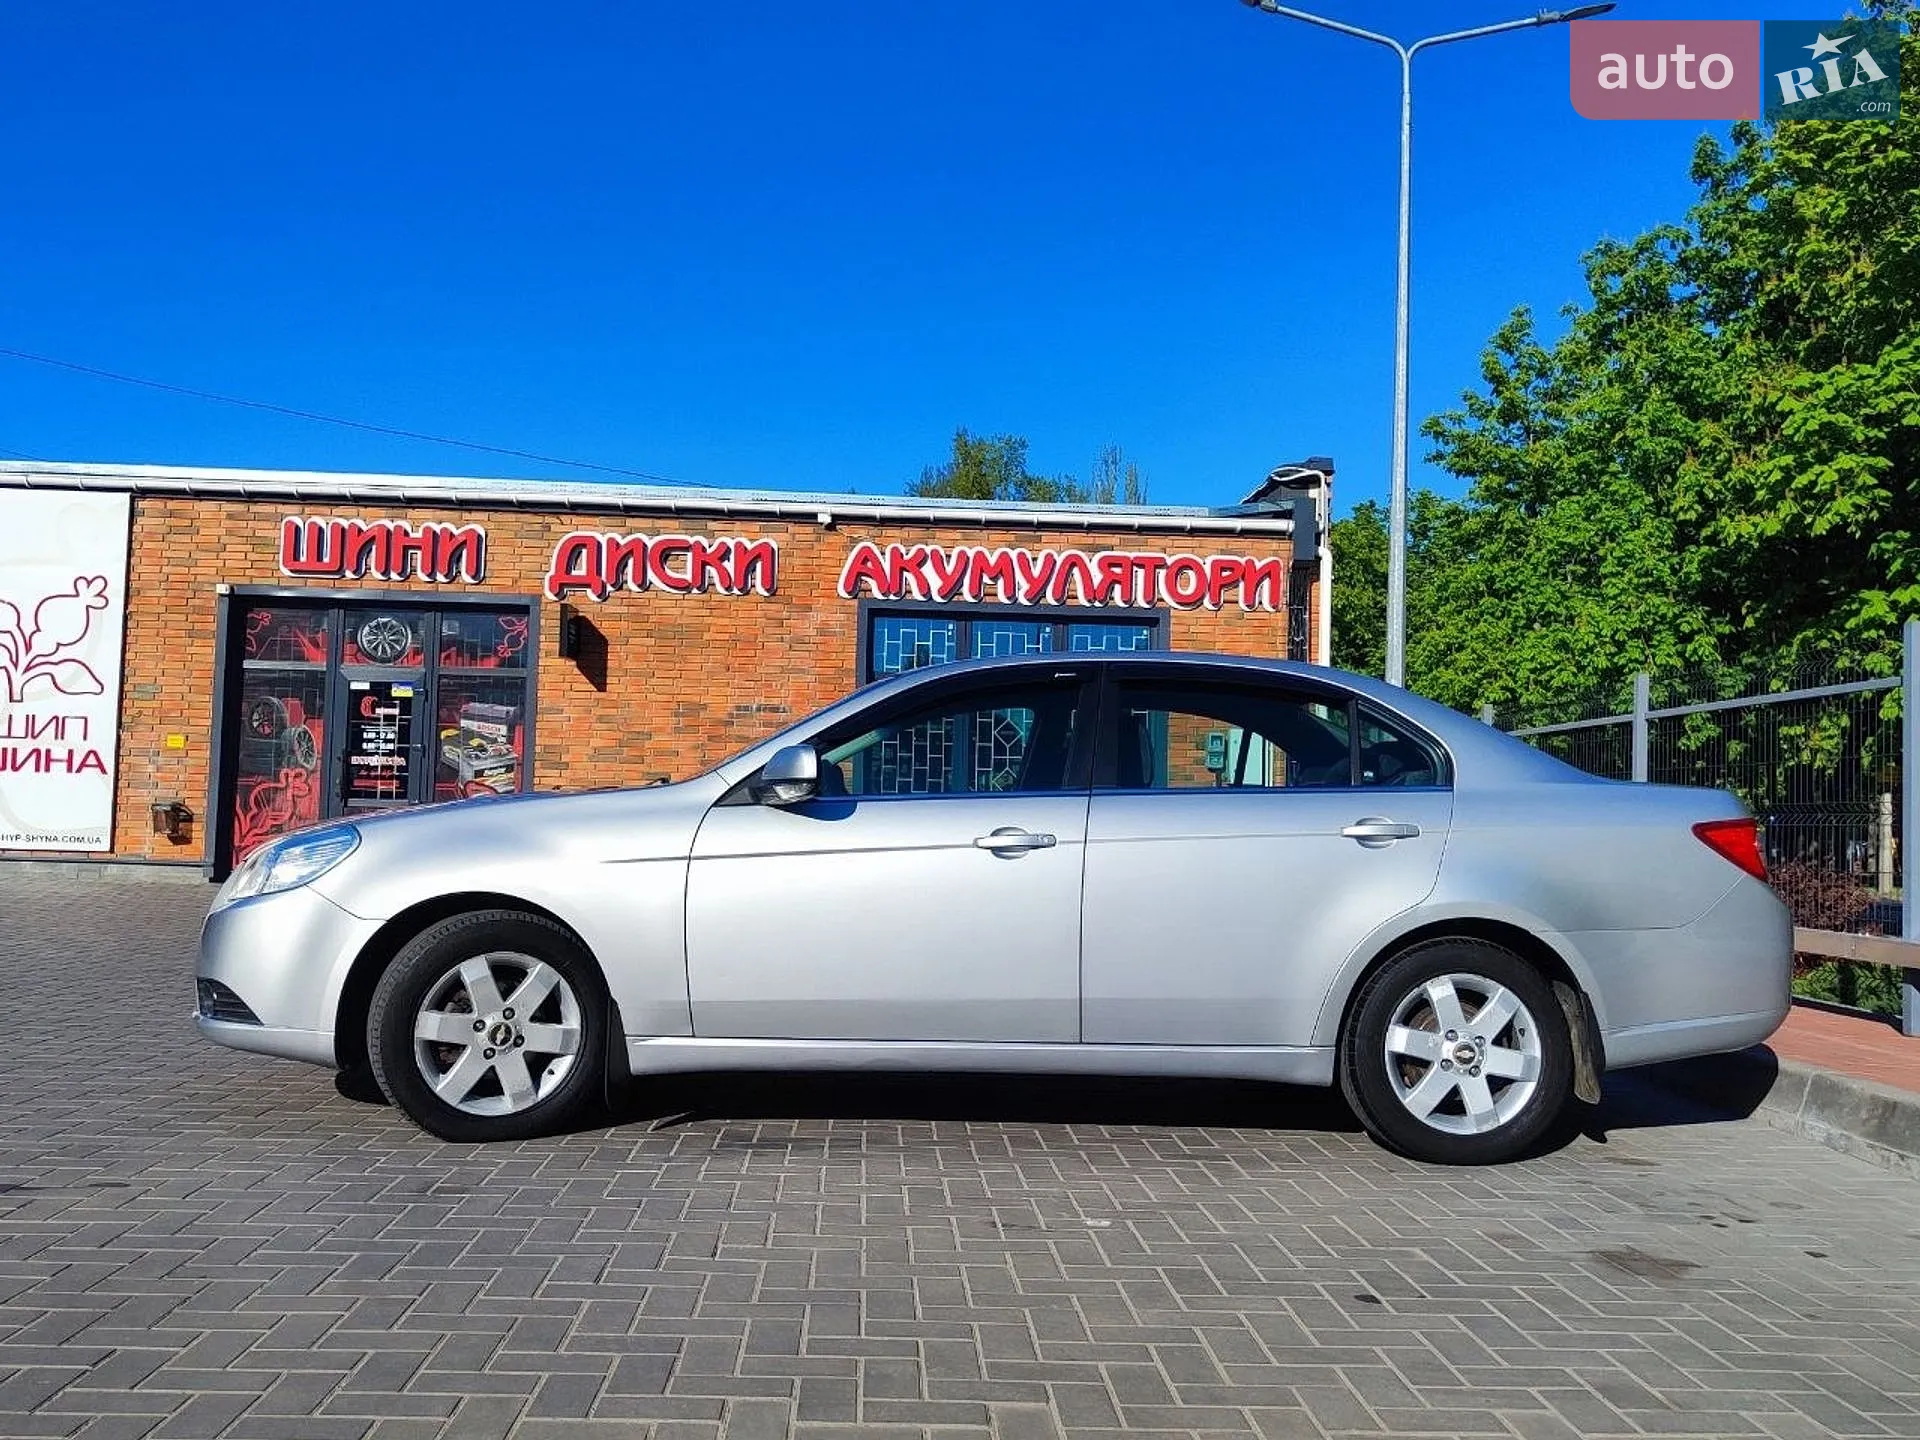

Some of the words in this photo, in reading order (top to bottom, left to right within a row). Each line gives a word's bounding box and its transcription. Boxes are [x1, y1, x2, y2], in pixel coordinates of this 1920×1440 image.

[280, 517, 485, 582] ШИНИ
[546, 532, 777, 600] ДИСКИ
[839, 543, 1284, 610] АКУМУЛЯТОРИ
[0, 747, 108, 775] ИНА
